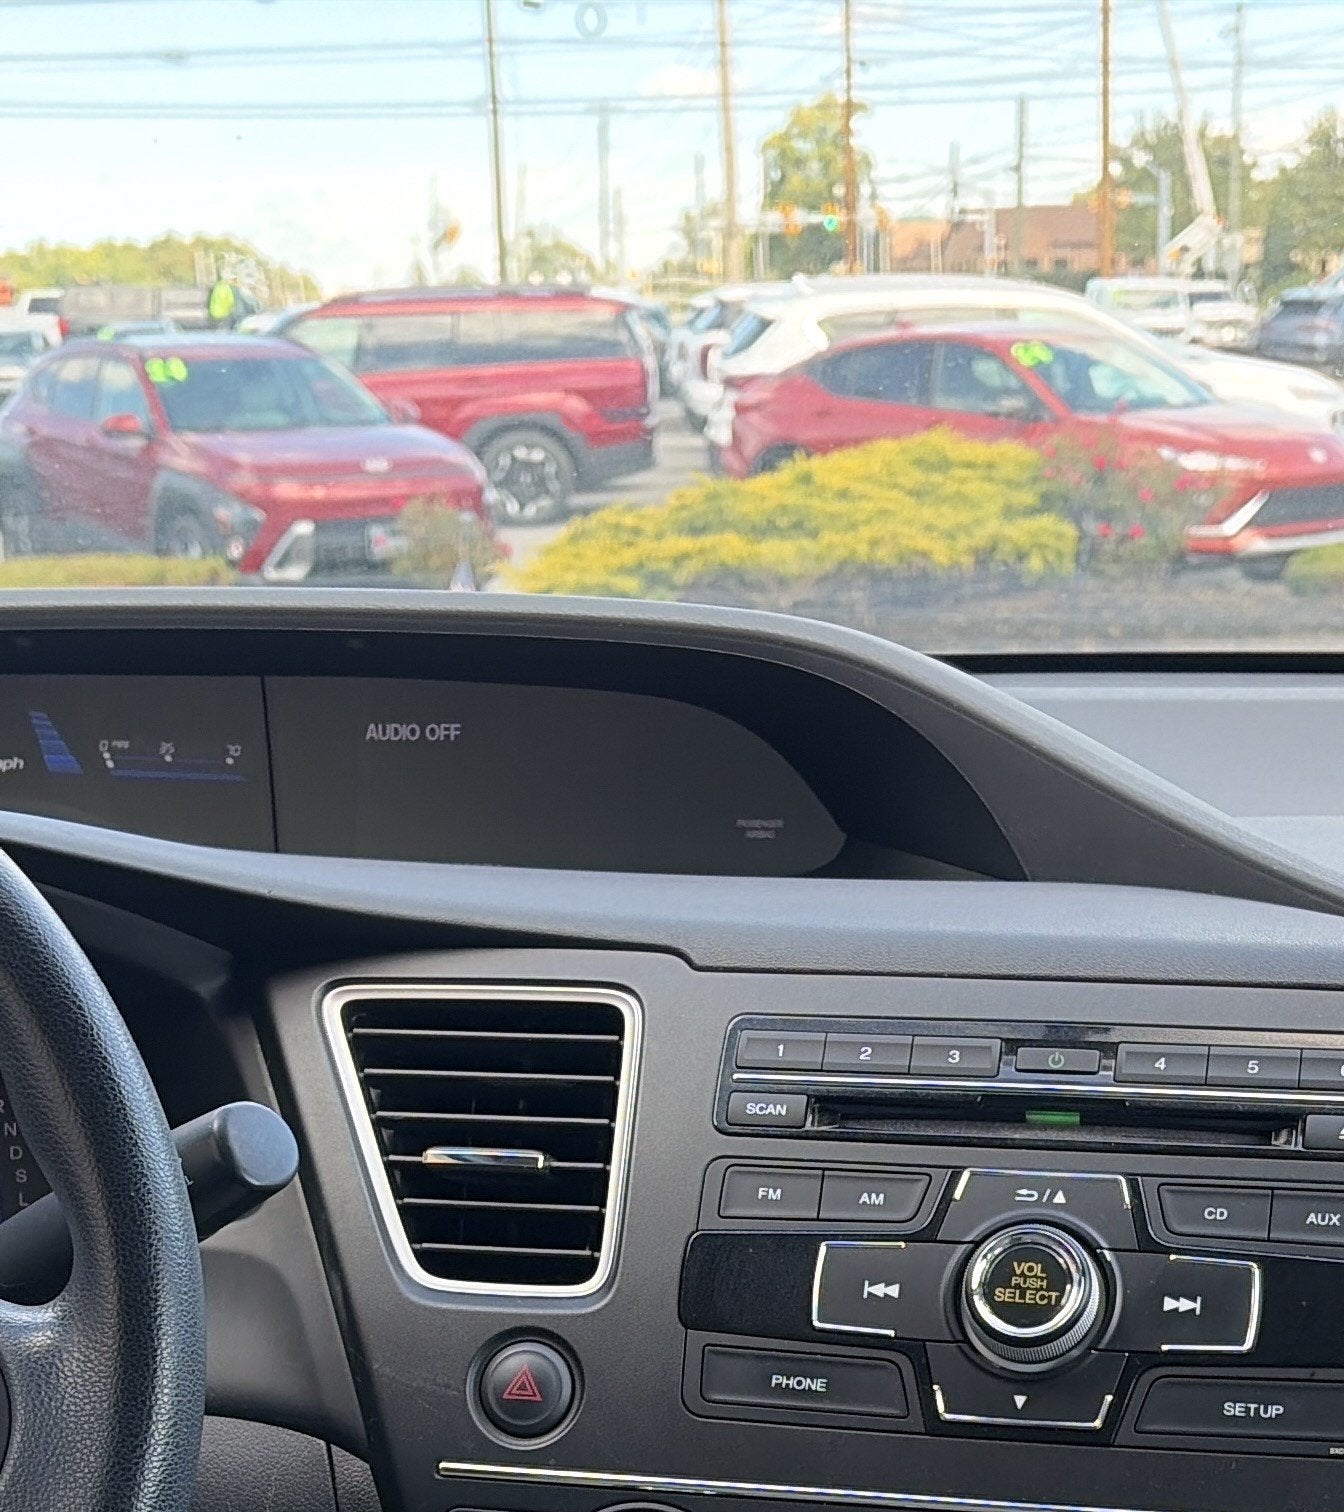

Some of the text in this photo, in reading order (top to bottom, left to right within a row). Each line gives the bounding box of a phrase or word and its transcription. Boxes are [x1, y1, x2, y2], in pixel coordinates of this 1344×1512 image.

[365, 723, 461, 741] AUDIO OFF
[777, 1043, 785, 1057] 1
[859, 1046, 872, 1061] 2
[947, 1050, 960, 1064] 3
[1154, 1056, 1166, 1070] 4
[1247, 1060, 1259, 1074] 5
[745, 1102, 787, 1117] SCAN
[4, 1122, 17, 1137] N
[9, 1146, 23, 1160] D
[15, 1168, 28, 1183] S
[757, 1187, 782, 1201] FM
[859, 1193, 884, 1206] AM
[1204, 1207, 1228, 1221] CD
[1306, 1212, 1341, 1226] AUX
[1013, 1261, 1047, 1277] VOL
[1011, 1276, 1047, 1289] PUSH
[994, 1287, 1060, 1305] SELECT
[771, 1374, 828, 1392] PHONE
[1223, 1402, 1284, 1418] SETUP
